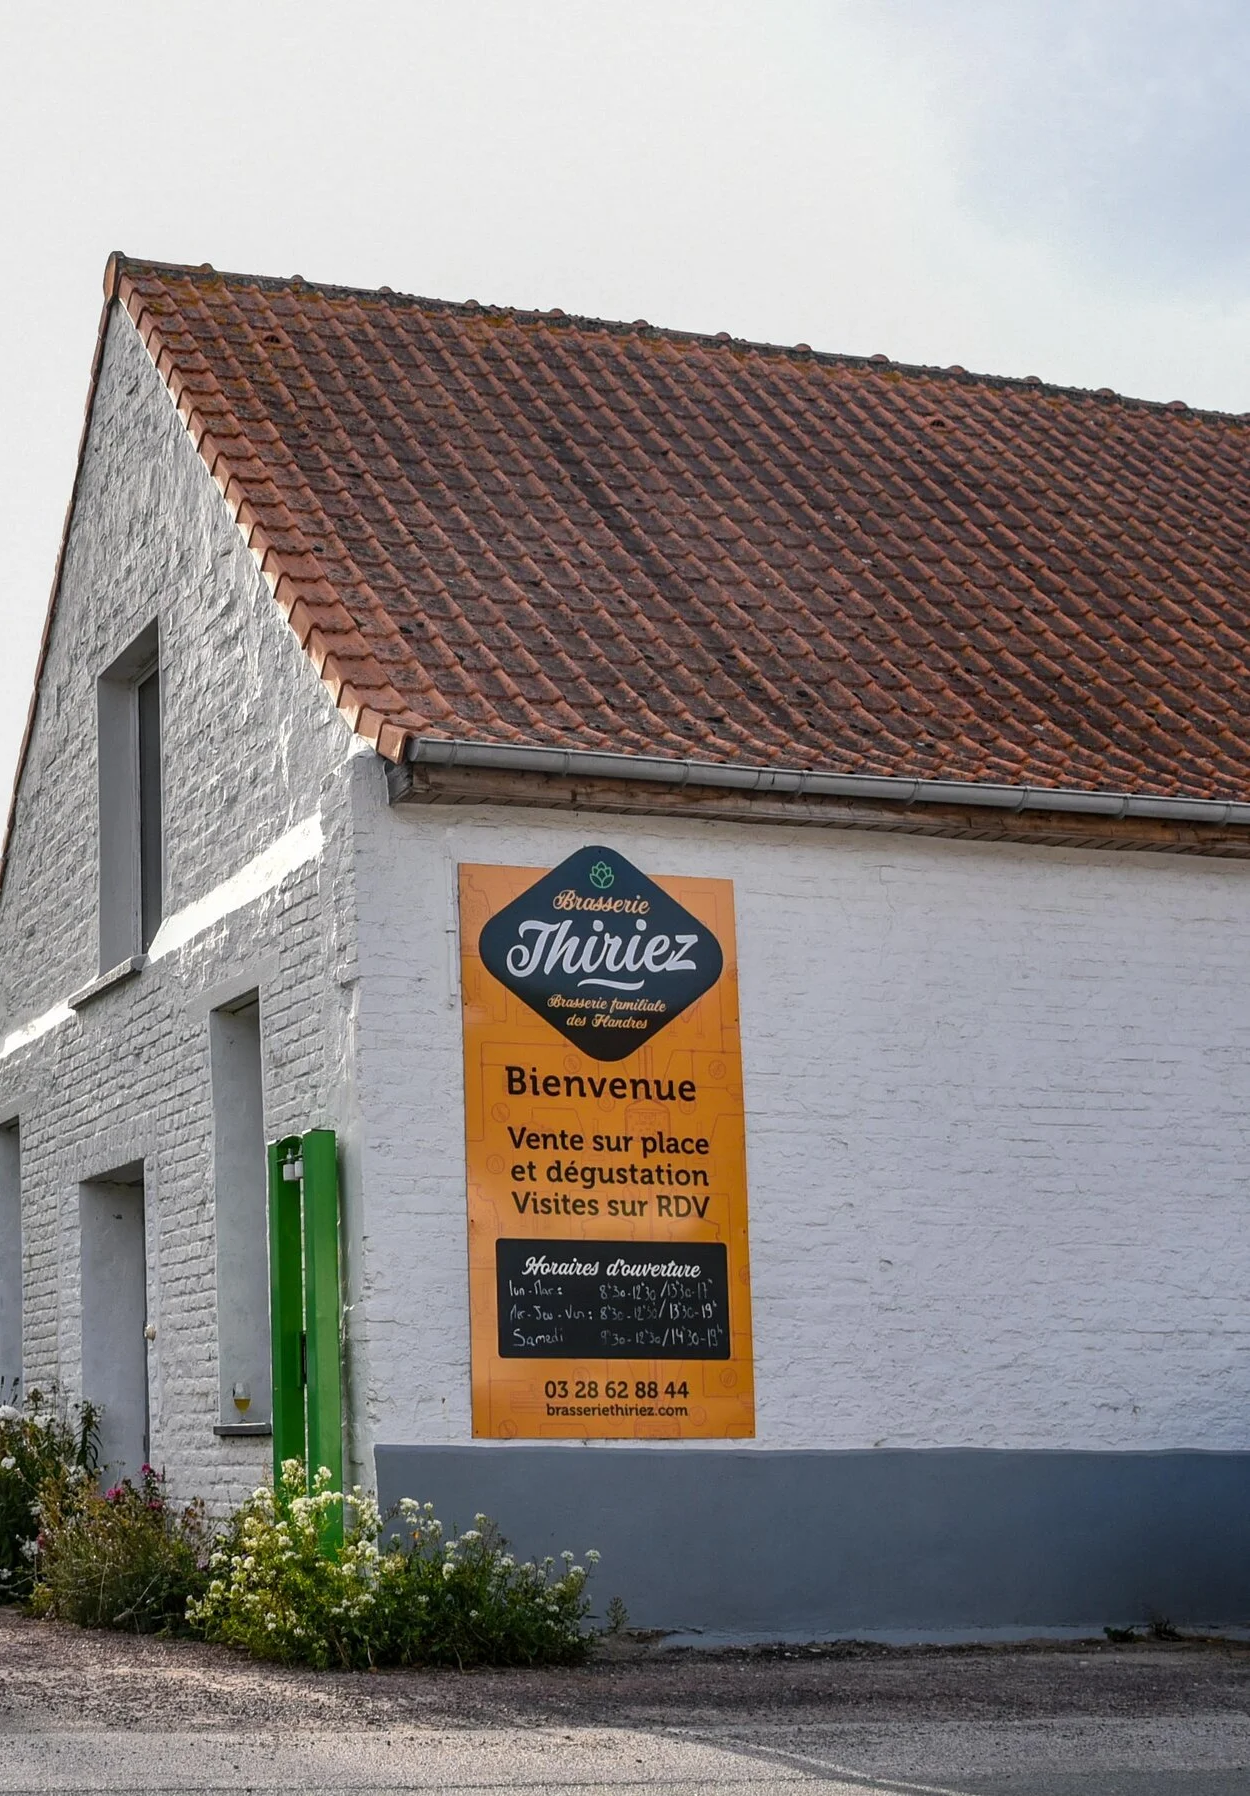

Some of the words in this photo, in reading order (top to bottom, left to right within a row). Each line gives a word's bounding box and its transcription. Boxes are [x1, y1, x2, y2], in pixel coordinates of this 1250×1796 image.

[552, 889, 651, 915] Brasserie
[506, 919, 699, 978] Thiriez
[547, 994, 608, 1010] Brasserie
[609, 997, 667, 1013] familiale
[566, 1013, 587, 1027] des
[591, 1013, 648, 1030] Flandres
[505, 1065, 697, 1102] Bienvenue
[507, 1126, 585, 1151] Vente
[592, 1134, 634, 1152] sur
[641, 1131, 710, 1158] place
[510, 1161, 537, 1182] et
[546, 1160, 710, 1189] dégustation
[511, 1191, 600, 1217] Visites
[607, 1199, 648, 1218] sur
[657, 1195, 711, 1218] RDV
[521, 1255, 600, 1277] Horaires
[606, 1258, 702, 1279] d'ouverture
[544, 1381, 569, 1398] 03
[574, 1381, 599, 1398] 28
[605, 1381, 629, 1398] 62
[635, 1381, 659, 1399] 88
[664, 1381, 690, 1399] 44
[546, 1403, 688, 1417] brasseriethiriez.com
